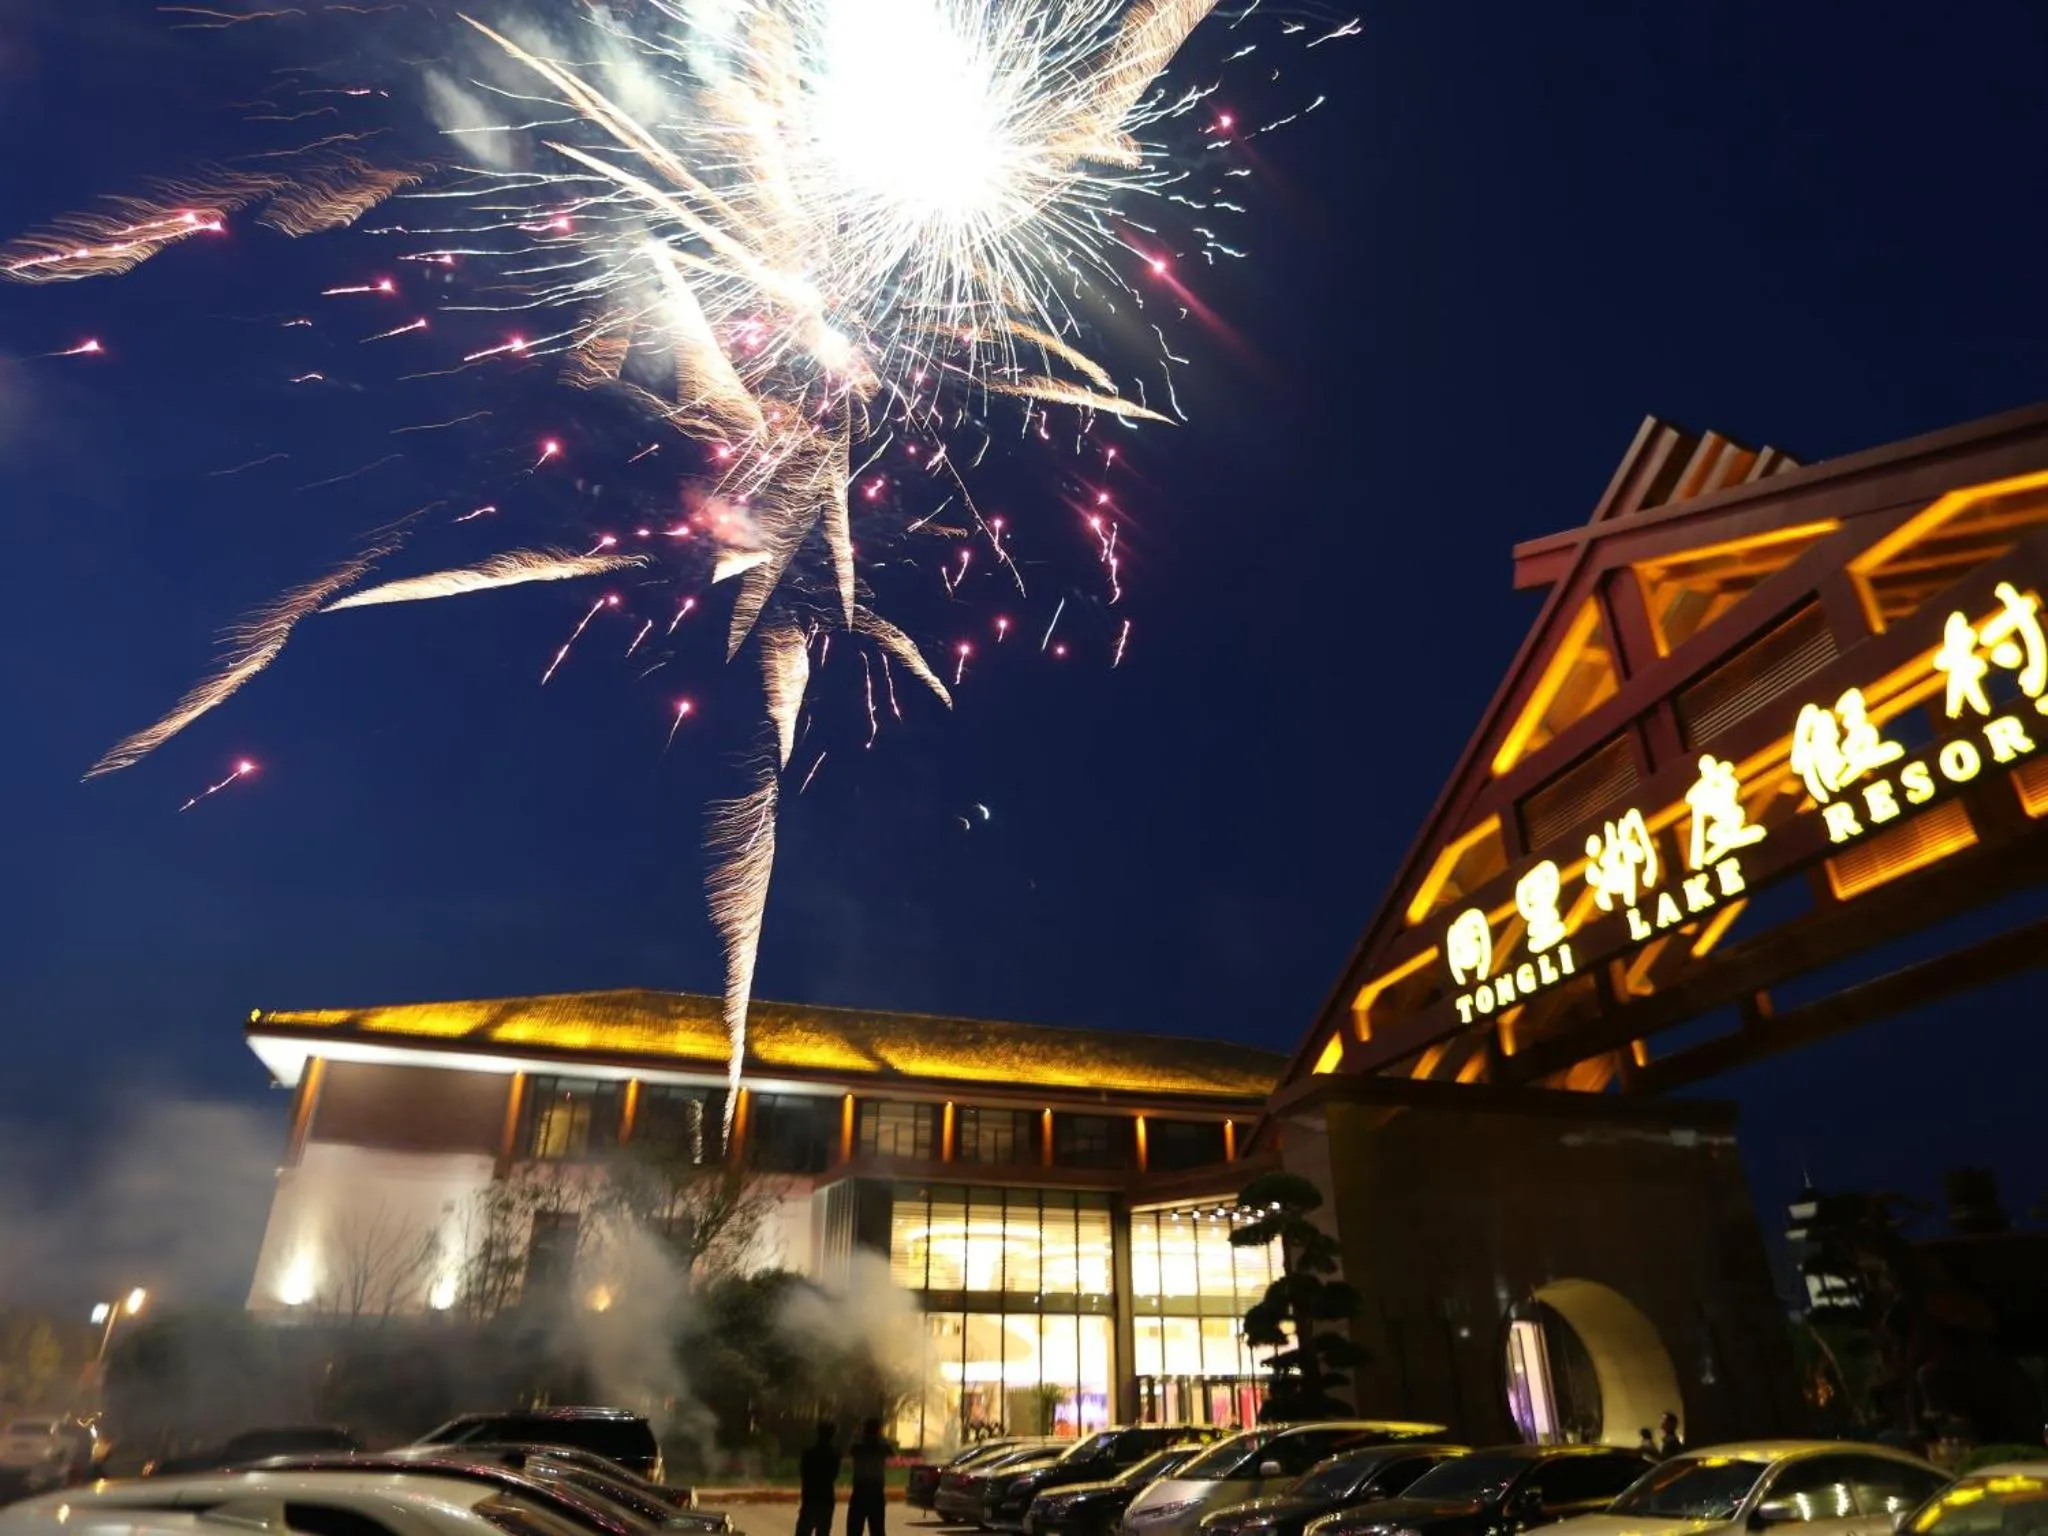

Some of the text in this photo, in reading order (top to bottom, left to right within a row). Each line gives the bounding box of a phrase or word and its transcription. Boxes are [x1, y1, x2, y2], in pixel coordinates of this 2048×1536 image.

[1455, 693, 2048, 1024] TONGLI LAKE RESOR
